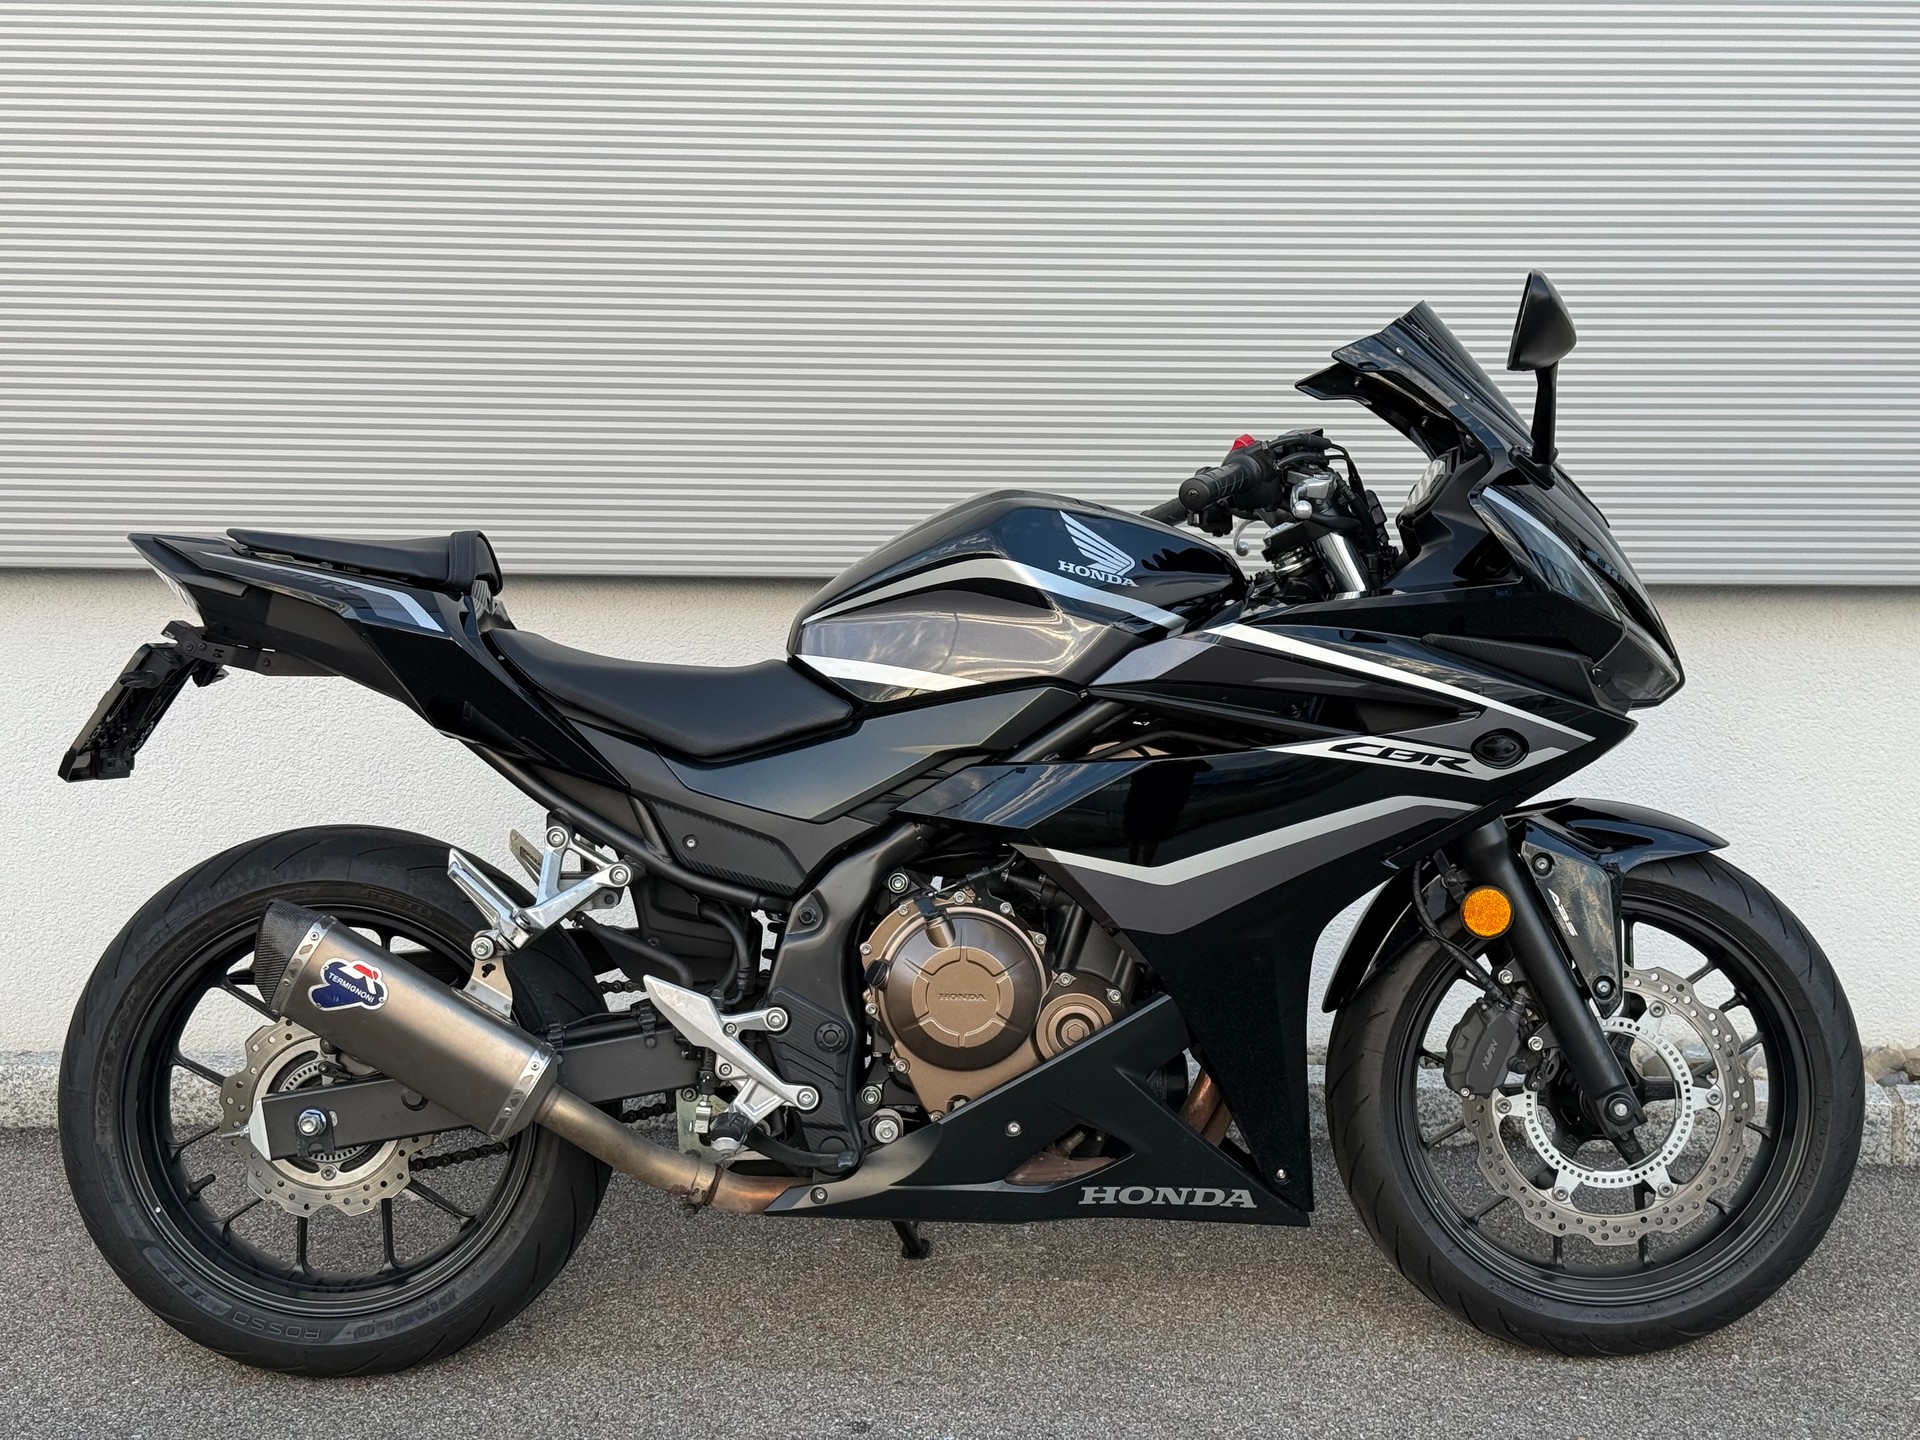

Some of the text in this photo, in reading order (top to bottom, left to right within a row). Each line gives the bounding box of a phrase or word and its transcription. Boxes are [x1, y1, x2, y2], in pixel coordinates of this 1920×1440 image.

[1058, 560, 1140, 588] HONDA
[1328, 742, 1474, 774] CBR
[1547, 888, 1578, 937] ABS
[328, 972, 375, 1003] TERMIGNONI
[939, 993, 988, 1002] HONDA
[1078, 1186, 1258, 1209] HONDA
[232, 1310, 321, 1341] ROSSO
